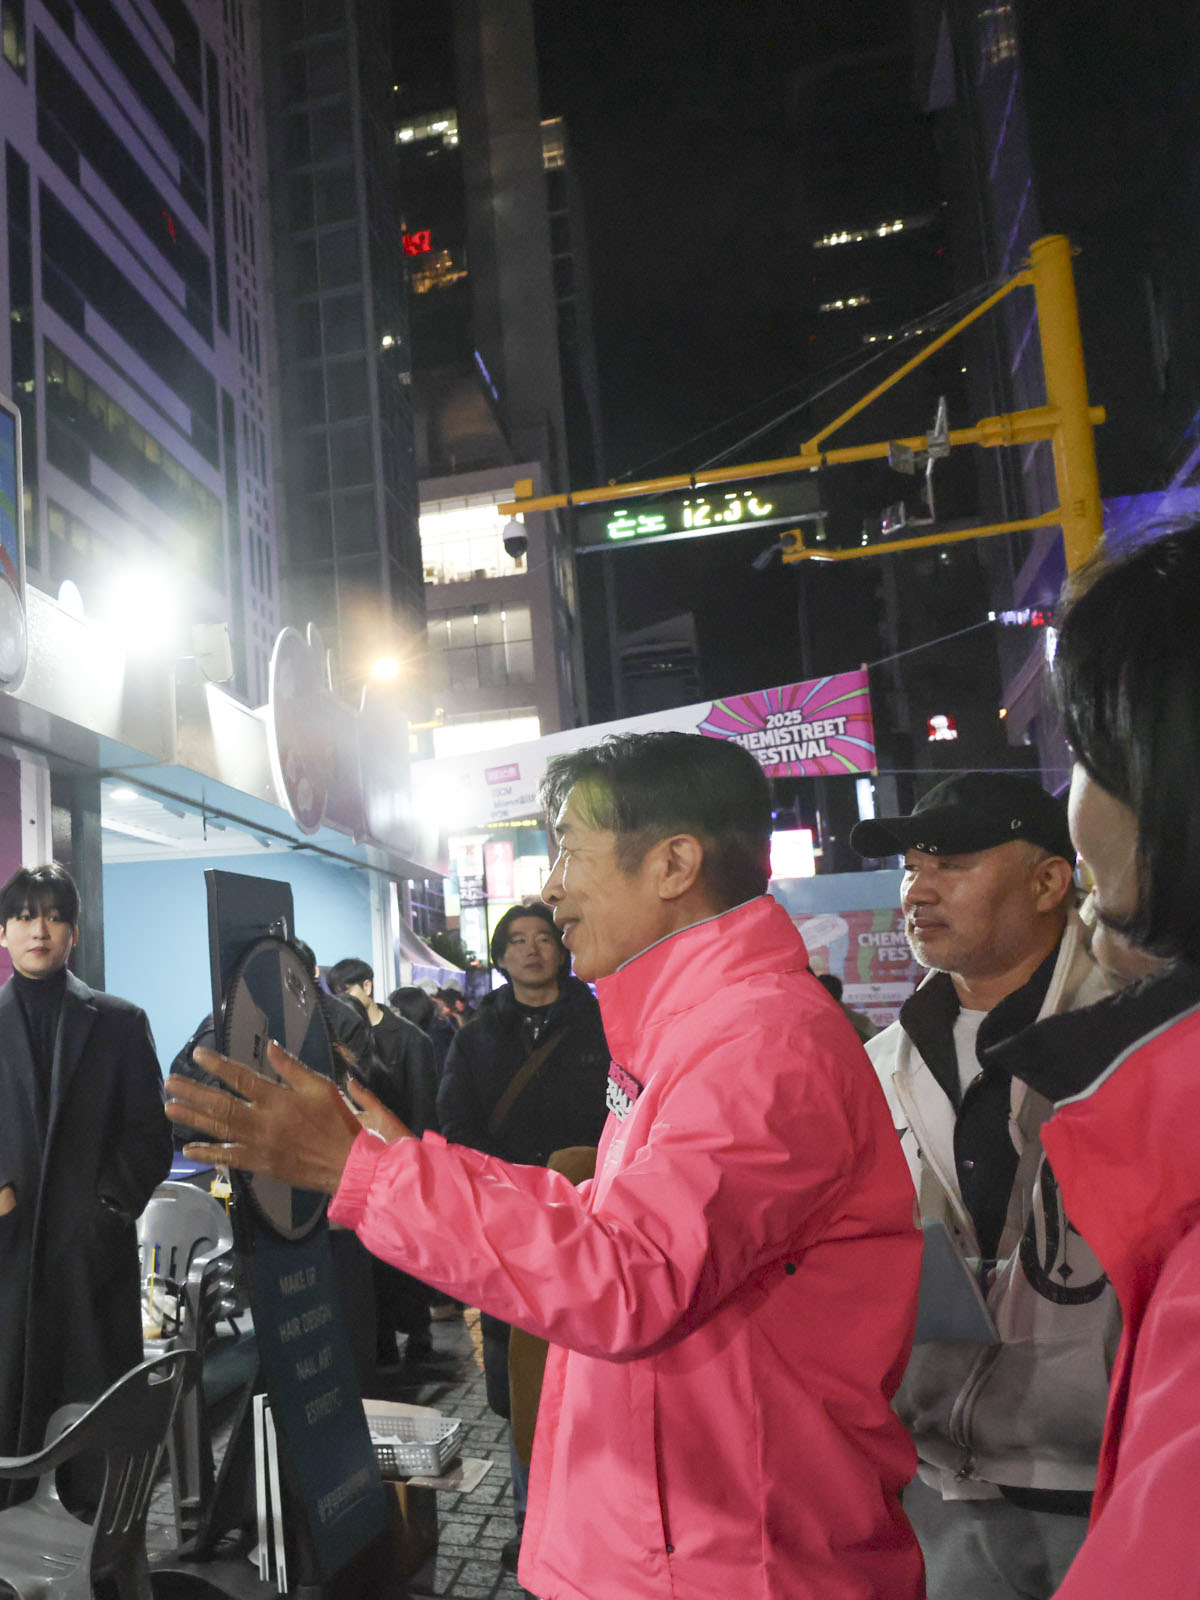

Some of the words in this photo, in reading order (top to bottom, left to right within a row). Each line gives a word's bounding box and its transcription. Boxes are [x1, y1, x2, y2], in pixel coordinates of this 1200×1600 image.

[766, 710, 802, 729] 2025
[728, 717, 847, 750] HEMISTREET
[858, 931, 906, 947] CHEM
[878, 946, 914, 962] FES
